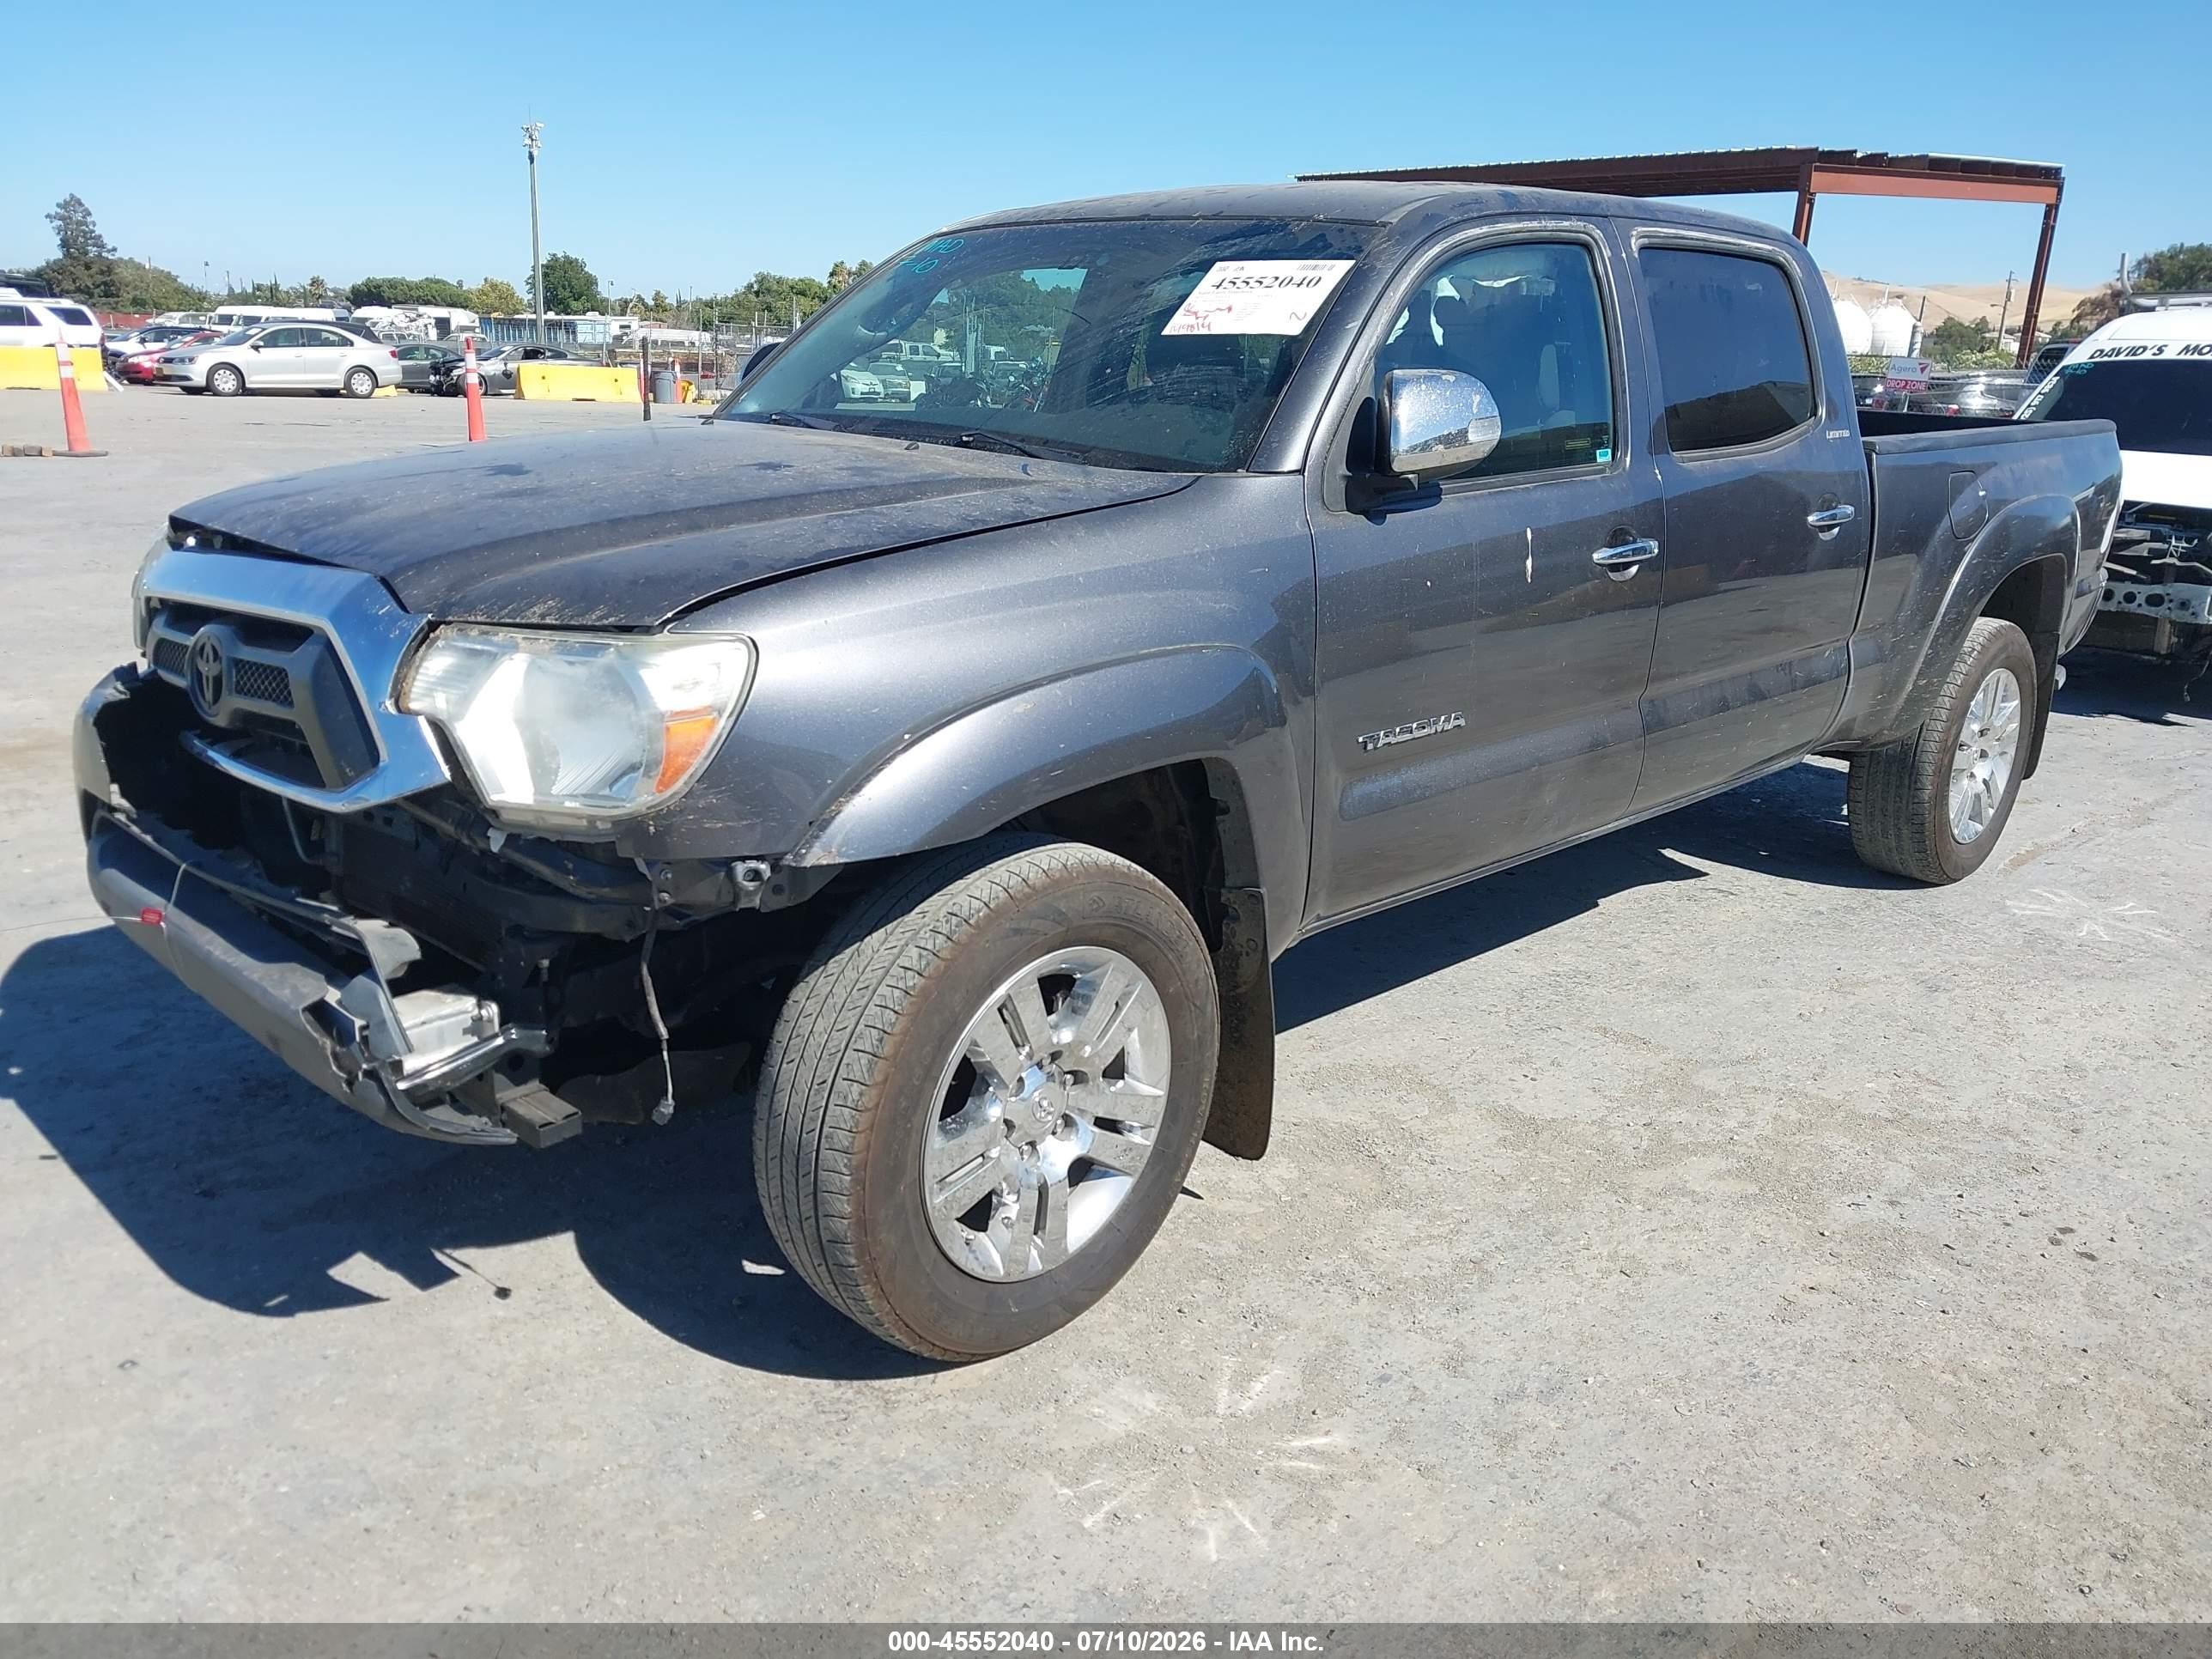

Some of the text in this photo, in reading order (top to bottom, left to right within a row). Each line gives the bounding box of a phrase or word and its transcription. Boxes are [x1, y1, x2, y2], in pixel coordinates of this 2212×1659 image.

[1211, 276, 1322, 289] 45552040
[2087, 343, 2169, 360] DAVID'S
[1890, 363, 1917, 374] Agero
[1887, 380, 1927, 391] DROP ZONE
[1357, 711, 1466, 751] TACOMA
